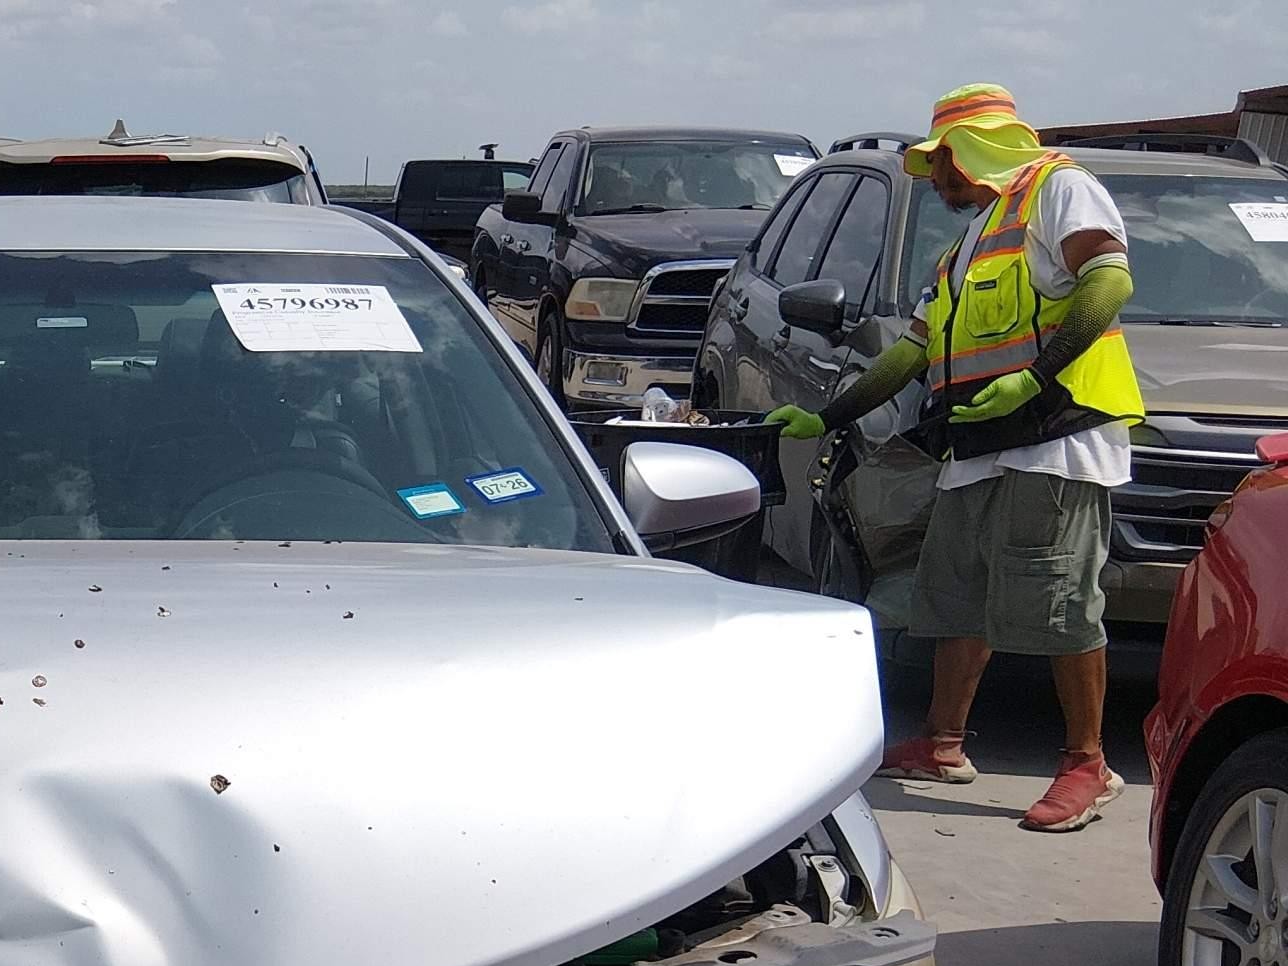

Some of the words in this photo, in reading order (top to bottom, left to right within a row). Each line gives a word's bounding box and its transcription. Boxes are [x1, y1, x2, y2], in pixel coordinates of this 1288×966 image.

[239, 297, 373, 311] 45796987
[481, 482, 500, 496] 07
[507, 478, 529, 491] 26
